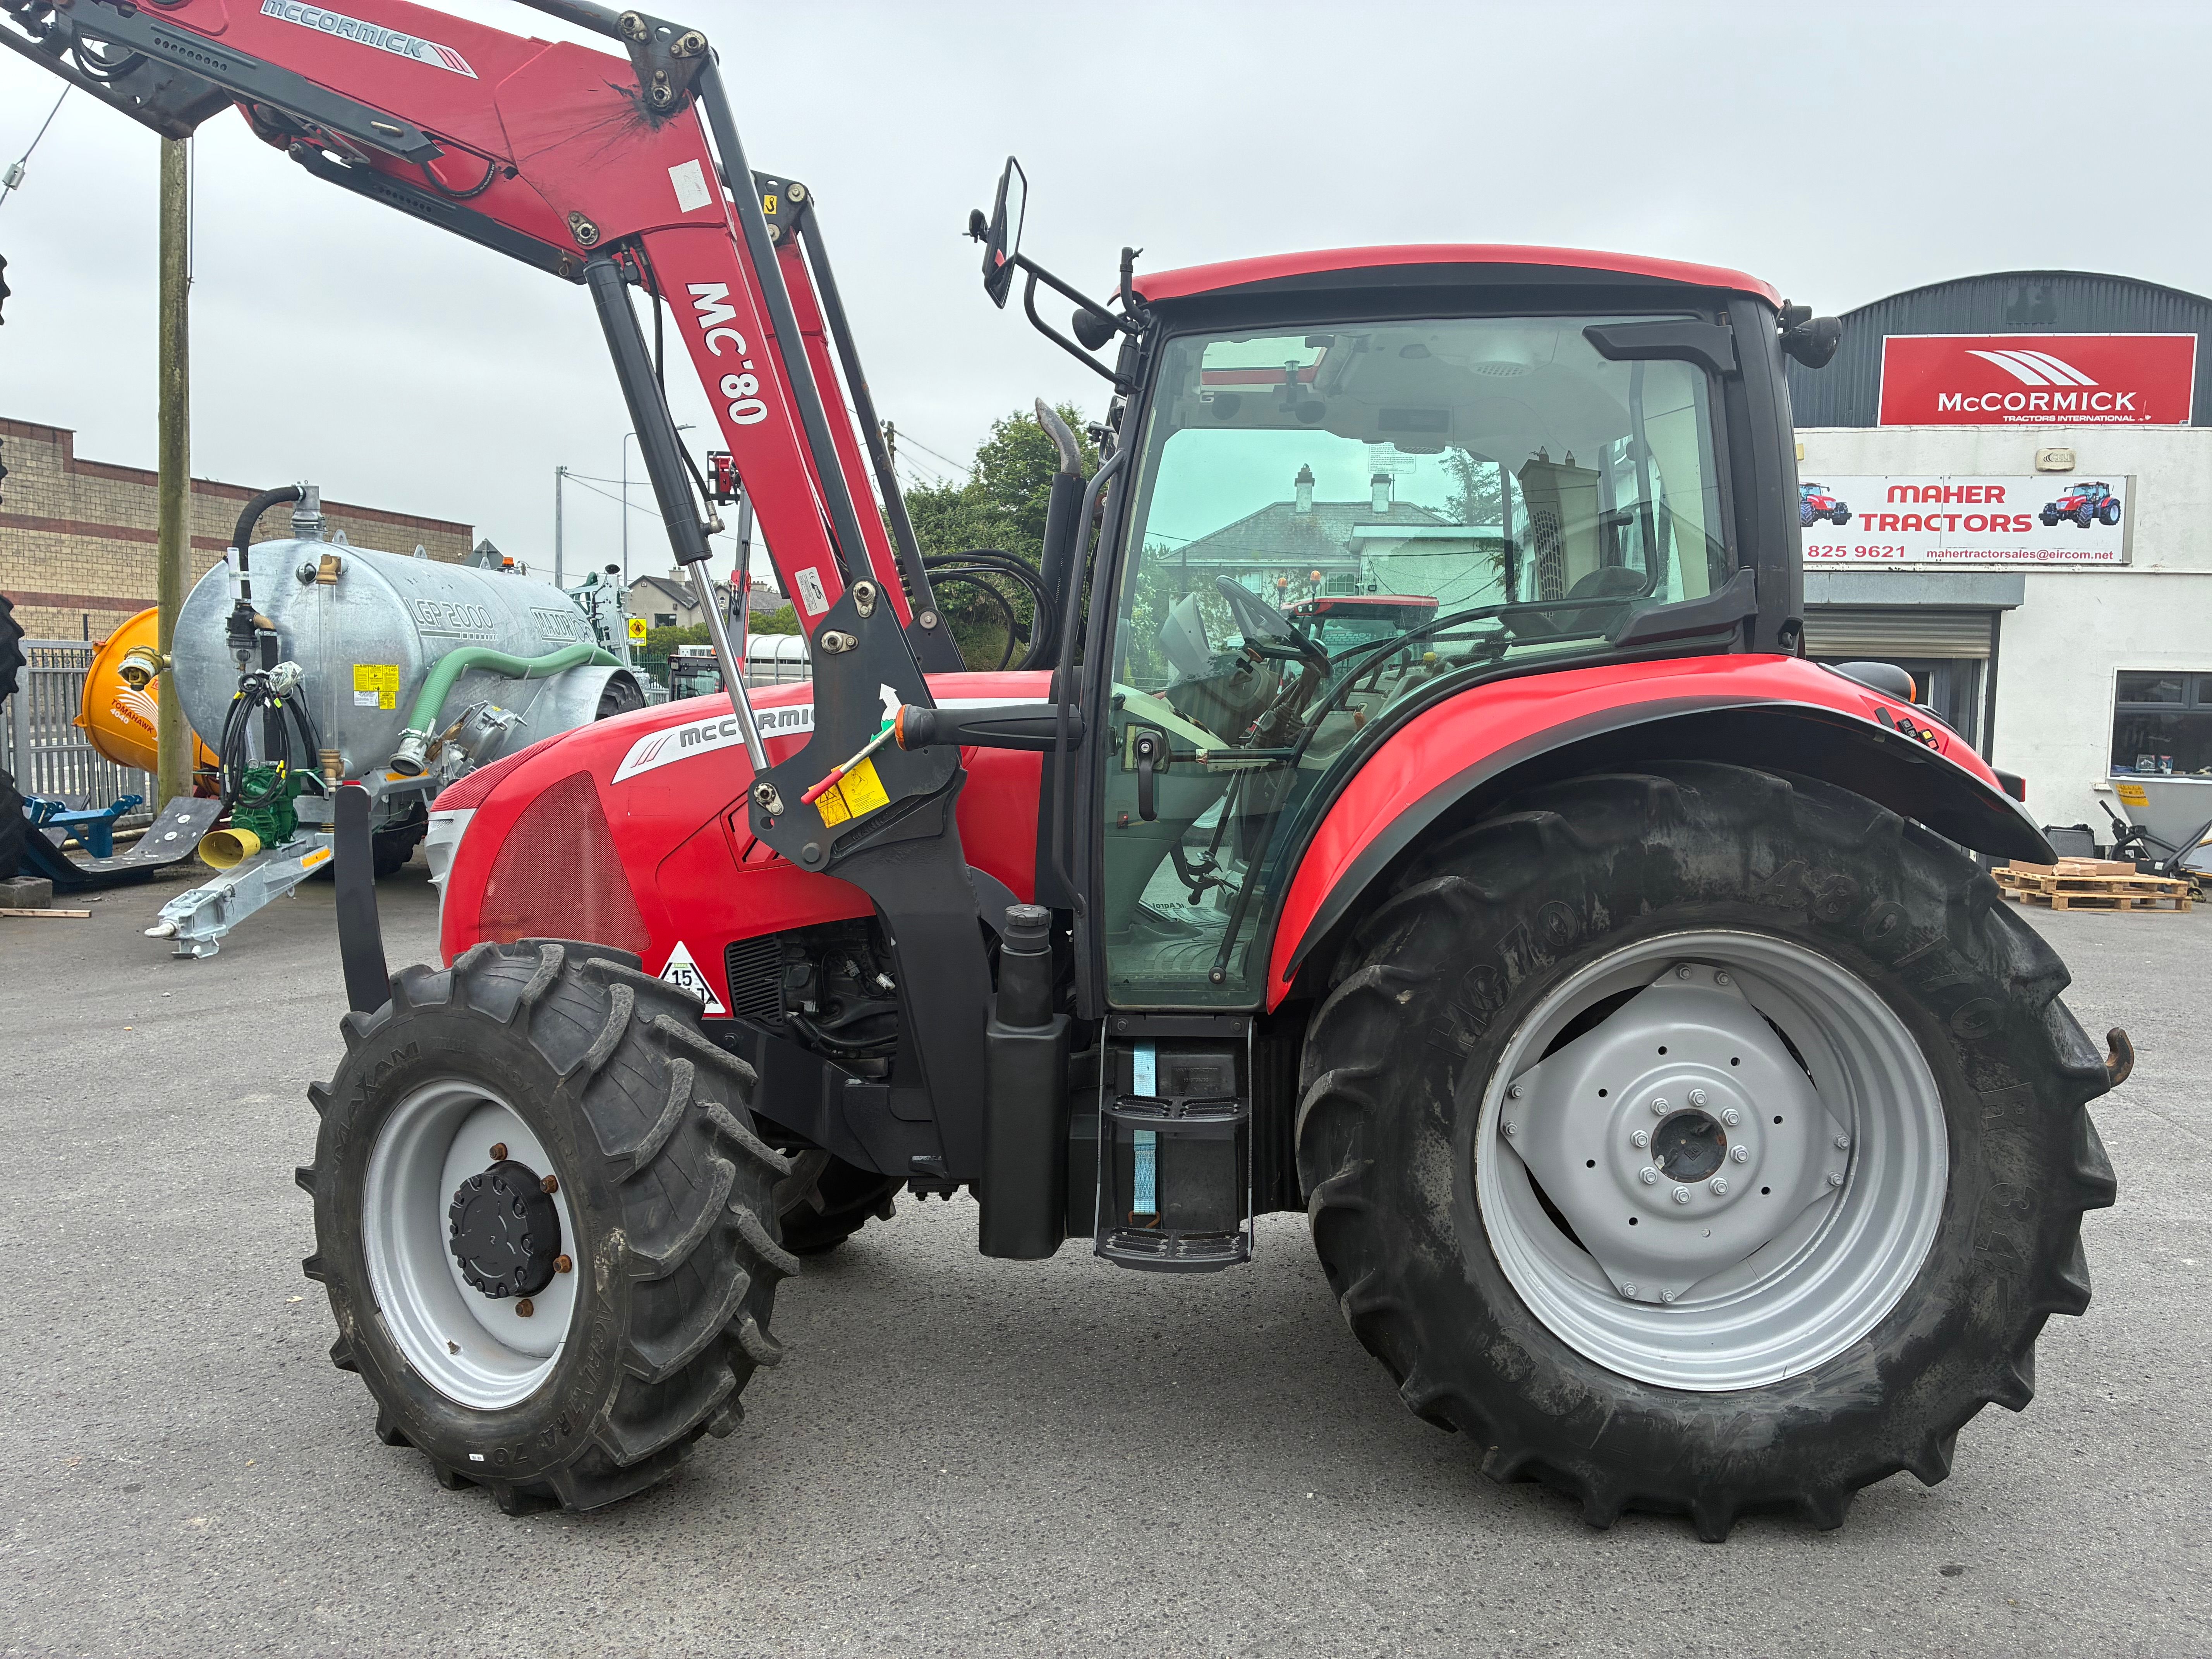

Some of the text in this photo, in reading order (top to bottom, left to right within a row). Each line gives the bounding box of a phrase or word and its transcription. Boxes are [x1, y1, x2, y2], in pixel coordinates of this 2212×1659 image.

[1938, 392, 2137, 411] McCORMICK
[1887, 486, 2006, 504] MAHER
[1858, 513, 2032, 532] TRACTORS
[1807, 545, 1905, 558] 825 9621
[1927, 548, 2114, 561] mahertractorsales@eircom.net
[403, 597, 494, 630] LGP 2000
[533, 611, 575, 637] MAJOR
[110, 708, 130, 724] 4040
[111, 698, 155, 734] TOMAHAWK
[679, 709, 815, 747] McCRMI
[672, 970, 692, 986] 15
